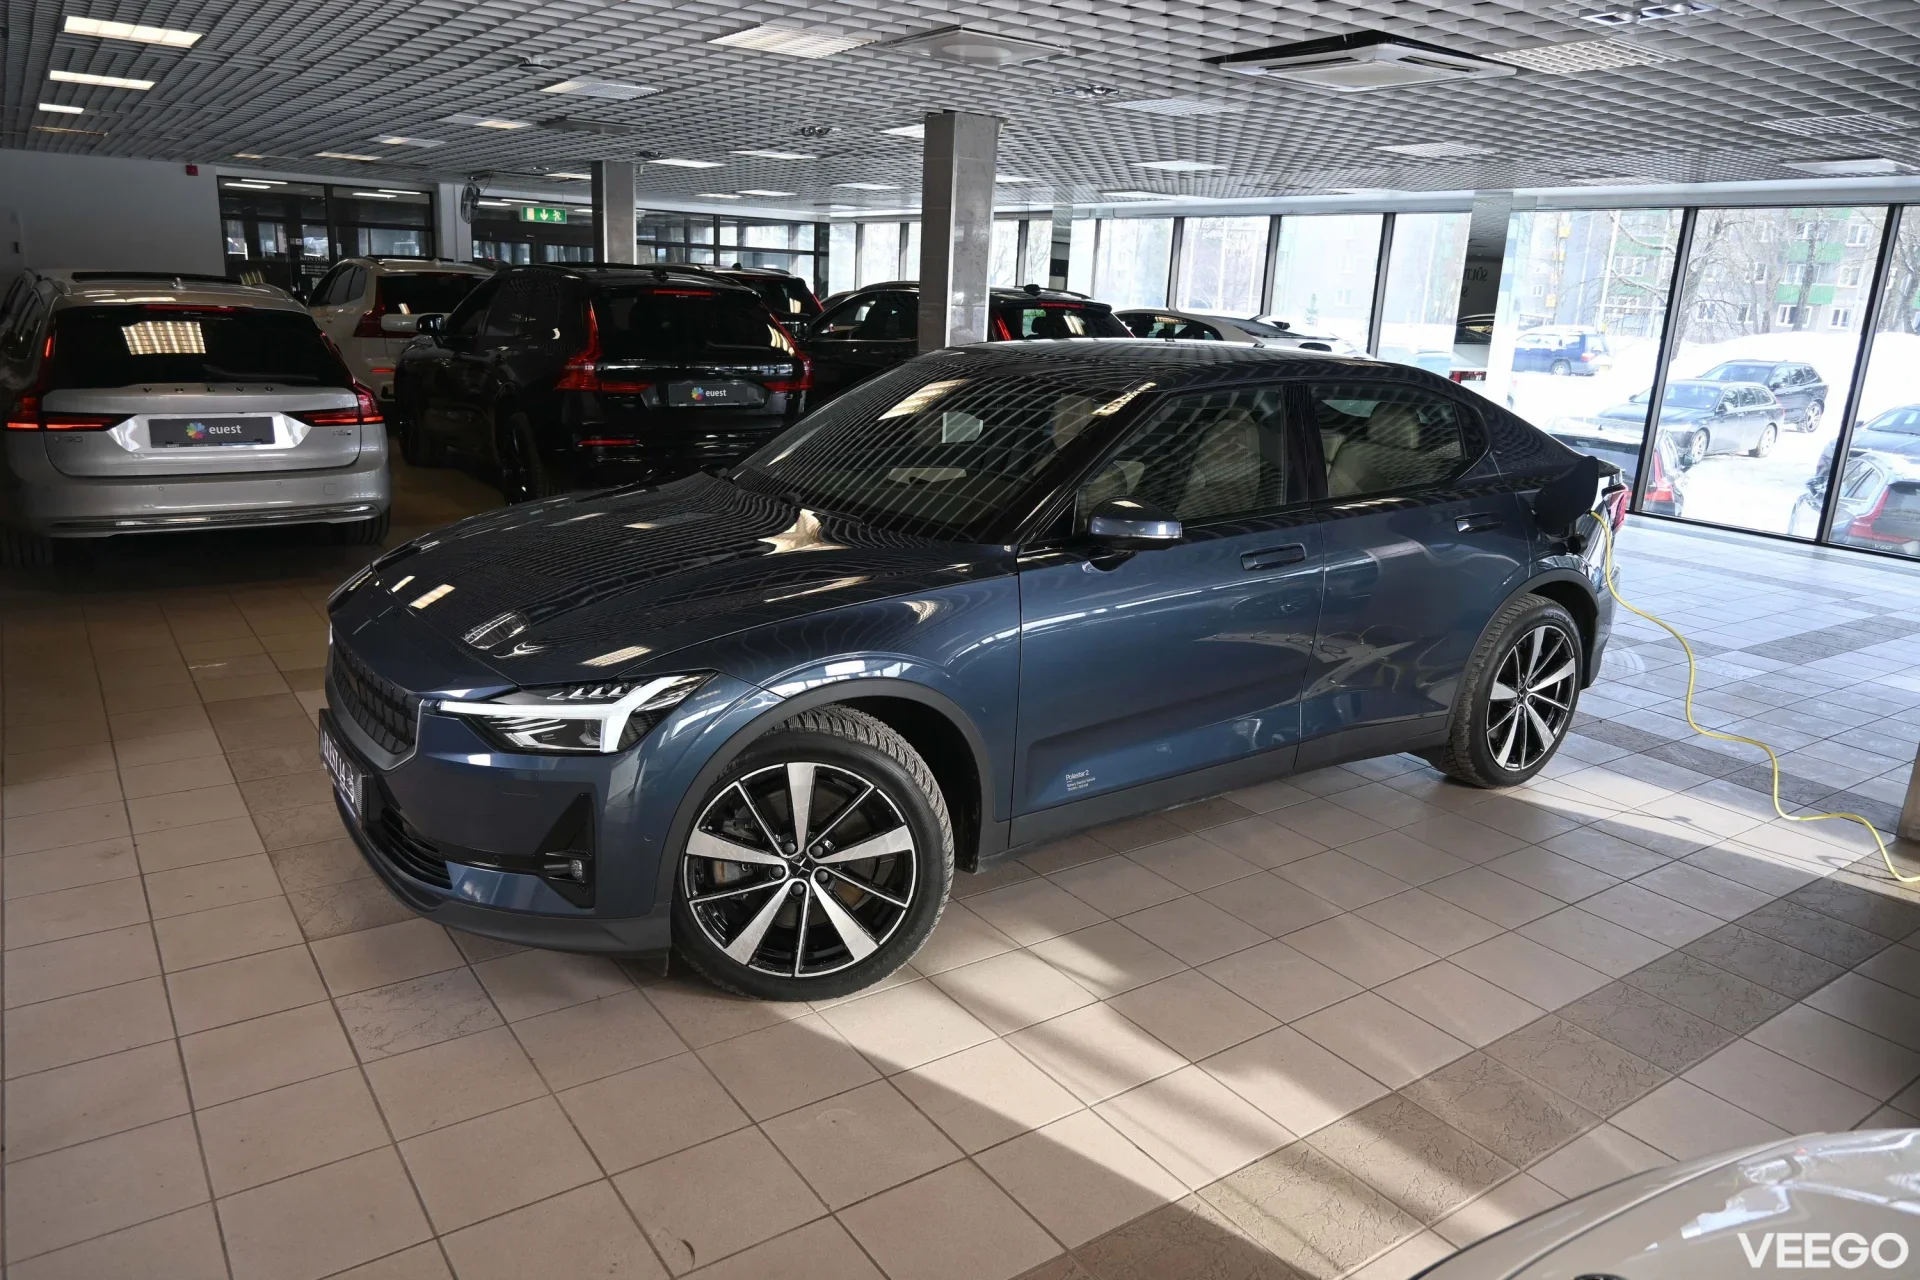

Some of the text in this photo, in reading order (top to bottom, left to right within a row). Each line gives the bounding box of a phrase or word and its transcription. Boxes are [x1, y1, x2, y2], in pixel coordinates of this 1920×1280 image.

[143, 386, 274, 394] VOLVO
[706, 388, 727, 397] euest
[208, 424, 242, 434] euest
